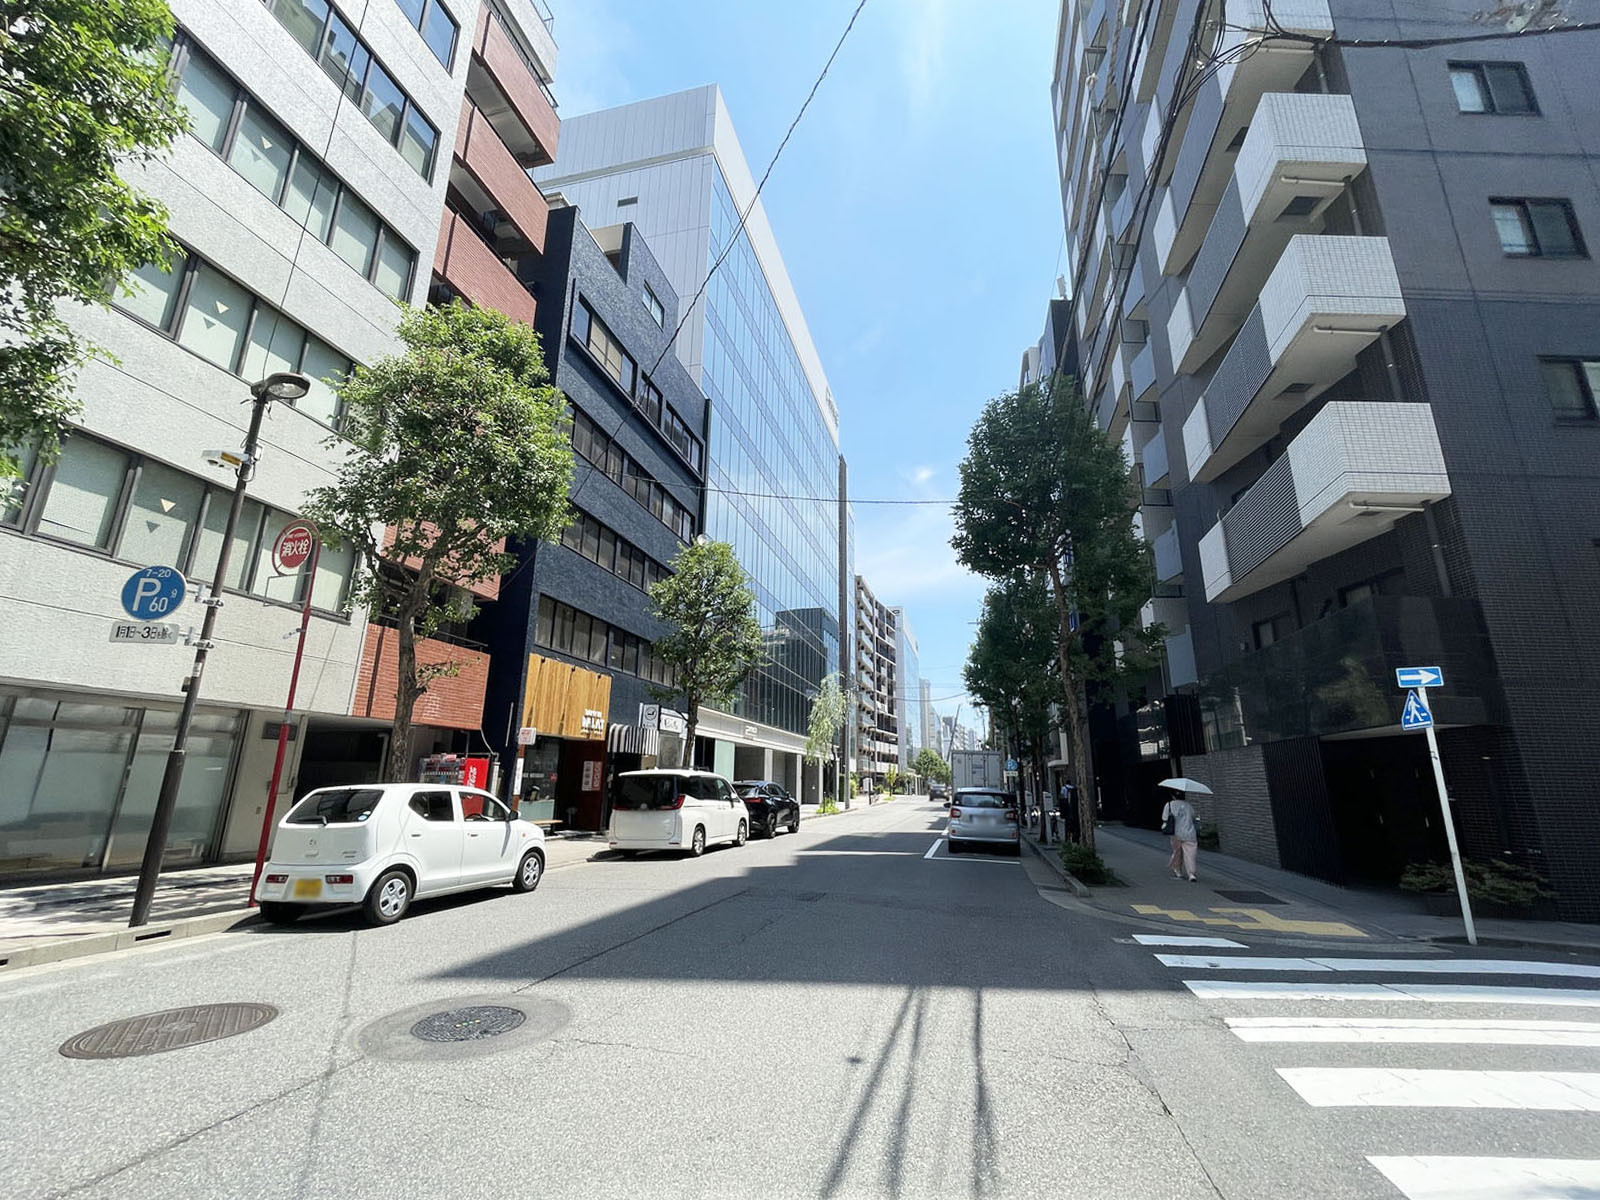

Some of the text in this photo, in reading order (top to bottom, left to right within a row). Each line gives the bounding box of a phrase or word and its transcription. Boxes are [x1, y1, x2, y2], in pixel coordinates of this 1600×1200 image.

[281, 539, 310, 557] 消火栓
[145, 569, 172, 578] 7-20
[131, 577, 162, 612] P
[148, 597, 169, 613] 60
